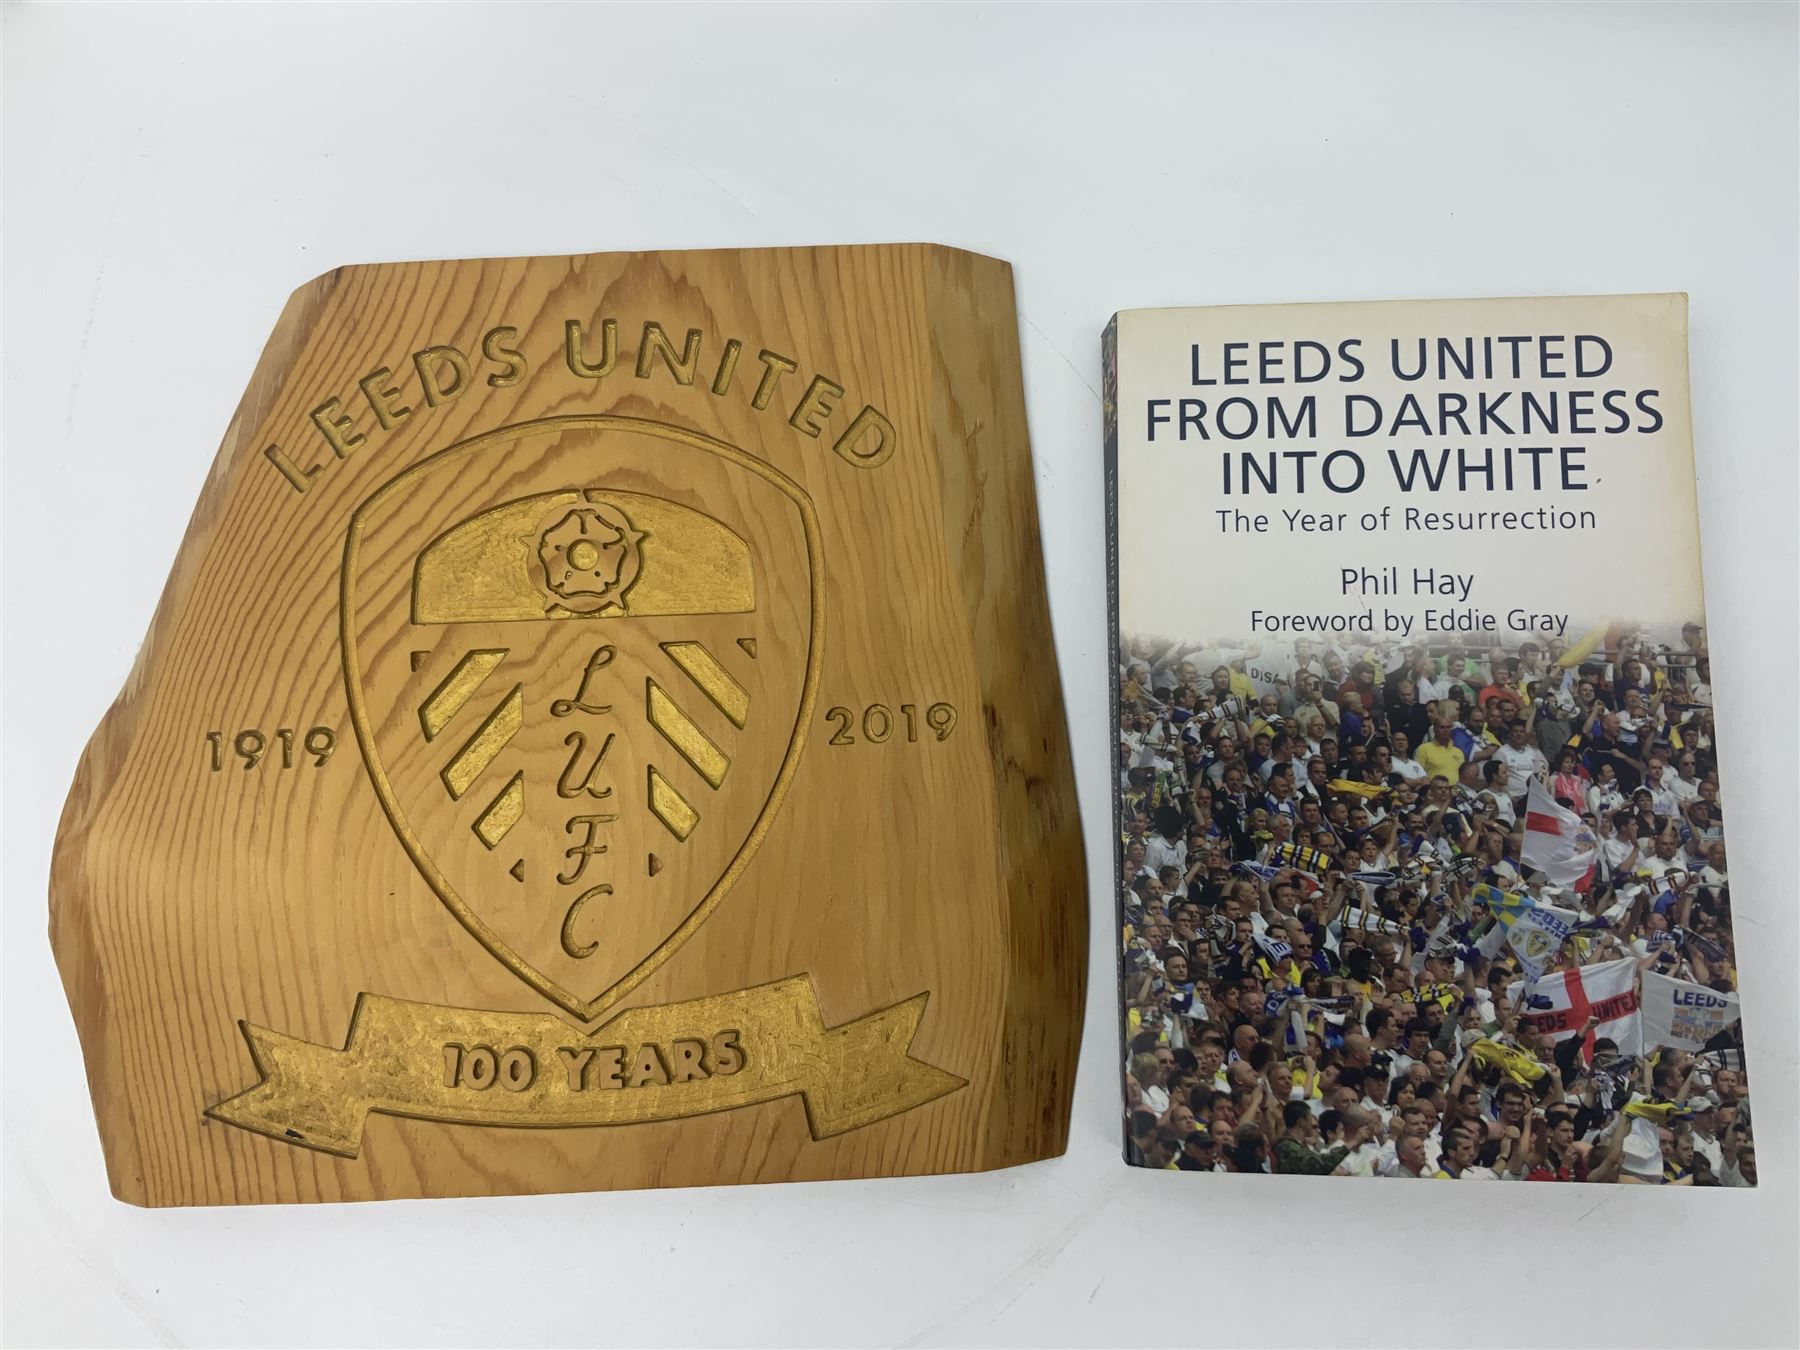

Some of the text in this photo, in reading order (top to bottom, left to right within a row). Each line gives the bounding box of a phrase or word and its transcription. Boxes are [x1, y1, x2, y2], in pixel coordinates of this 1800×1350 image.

[1191, 334, 1614, 386] LEEDS UNITED
[264, 319, 898, 494] LEEDS UNITED
[1146, 389, 1664, 442] FROM DARKNESS
[1222, 446, 1588, 495] INTO WHITE
[1215, 505, 1596, 533] The Year of Resurrection
[1341, 566, 1474, 603] Phil Hay
[1251, 608, 1569, 637] Foreword by Eddie Gray
[825, 702, 957, 745] 2019
[206, 726, 336, 772] 1919
[1673, 989, 1728, 1008] LEEDS
[442, 1029, 747, 1093] 100 YEARS
